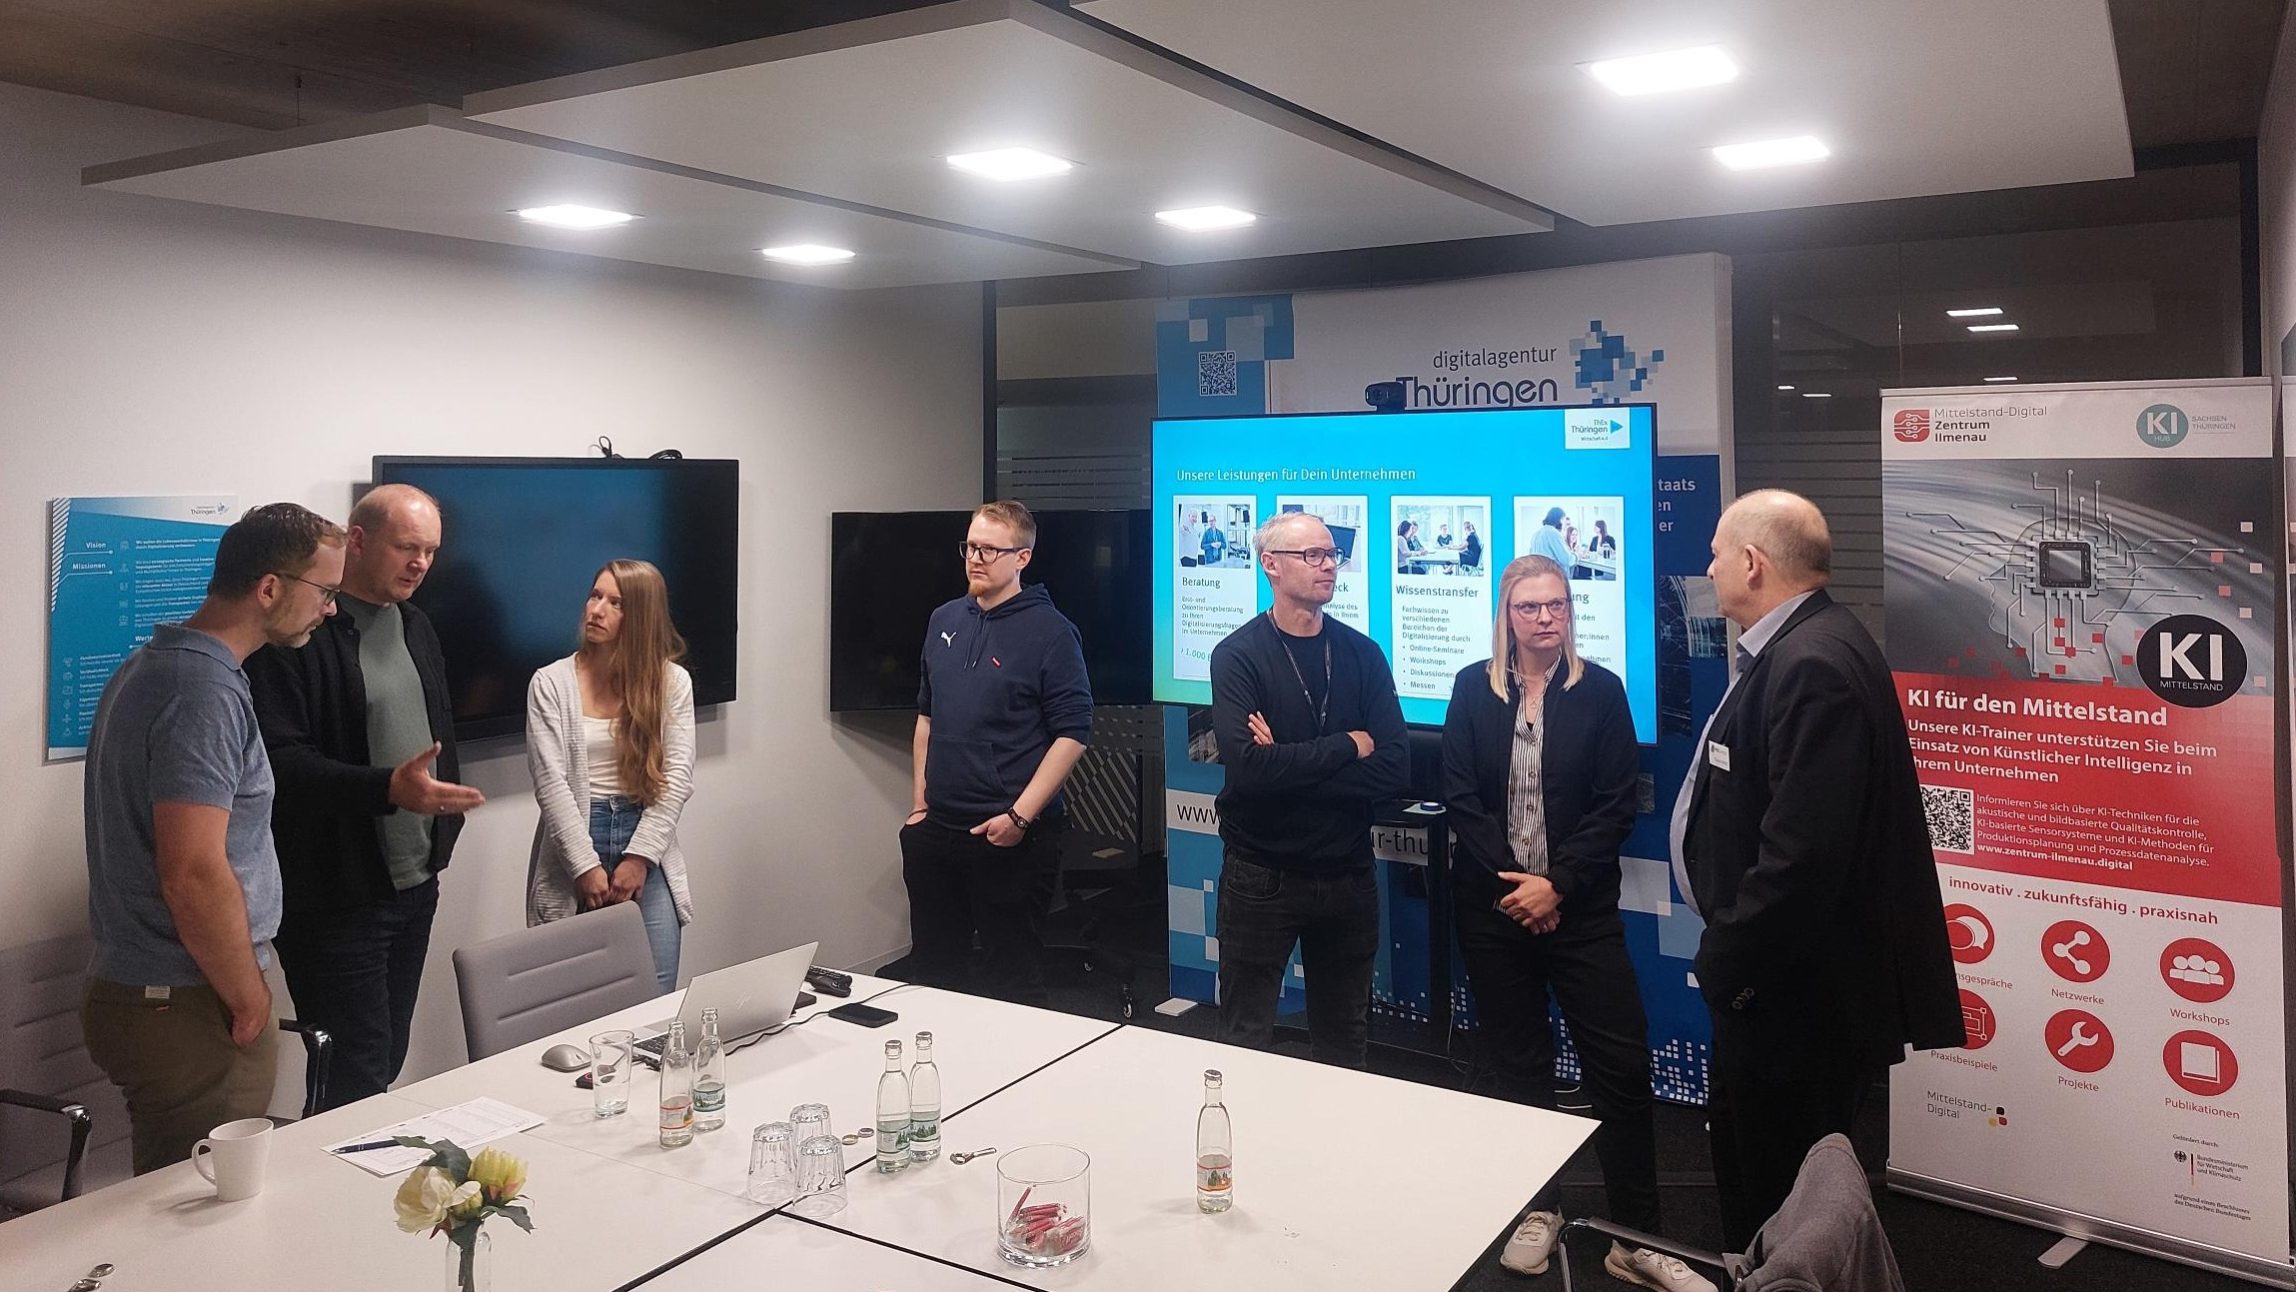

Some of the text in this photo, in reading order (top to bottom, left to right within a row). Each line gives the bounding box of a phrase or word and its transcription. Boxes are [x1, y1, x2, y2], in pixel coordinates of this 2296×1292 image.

[1432, 347, 1557, 371] digitalagentur
[1396, 376, 1558, 407] Thüringen
[1934, 406, 2047, 418] Mittelstand-Digital
[1571, 426, 1608, 434] Thüringen
[1935, 420, 1990, 430] Zentrum
[2147, 412, 2178, 435] KI
[1935, 433, 1987, 442] Ilmenau
[1177, 468, 1416, 483] Unsere Leistungen für Dein Unternehmen
[1658, 478, 1696, 491] taats
[1659, 521, 1674, 532] er
[85, 541, 106, 549] Vision
[72, 562, 106, 570] Missionen
[1182, 577, 1220, 589] Beratung
[1333, 582, 1349, 593] eck
[1396, 585, 1479, 598] Wissenstransfer
[1402, 605, 1439, 614] Fachwissen
[1402, 615, 1450, 623] verschiedenen
[1402, 624, 1435, 632] Bereichen
[1402, 633, 1470, 642] Digitalisierung durch
[1410, 644, 1464, 654] Online-Seminare
[2159, 632, 2223, 681] KI
[1410, 656, 1446, 666] Workshops
[1410, 668, 1454, 678] Diskussionen
[1410, 681, 1435, 689] Messen
[2160, 680, 2223, 692] MITTELSTAND
[1908, 689, 2167, 726] KI für den Mittelstand
[1908, 719, 2217, 757] Unsere KI-Trainer unterstützen Sie beim
[1909, 737, 2192, 775] Einsatz von Künstlicher Intelligenz in
[1914, 756, 2059, 783] hrem Unternehmen
[1977, 794, 2200, 826] Informieren Sie sich über KI-Techniken für die
[1977, 807, 2207, 841] akustische und bildbasierte Qualitätskontrolle,
[1977, 818, 2214, 853] KI-basierte Sensorsysteme und KI-Methoden für
[1977, 830, 2210, 867] Produktionsplanung und Prozessdatenanalyse.
[1977, 844, 2133, 871] www.zentrum-ilmenau.digital
[1949, 876, 2218, 924] innovativ zukunftsfähig praxisnah
[1956, 973, 2013, 989] nsgespräche
[2051, 988, 2105, 1005] Netzwerke
[2170, 1008, 2230, 1026] Workshops
[1930, 1050, 1998, 1072] Praxisbeispiele
[2058, 1076, 2099, 1091] Projekte
[1927, 1090, 1992, 1112] Mittelstand-
[2165, 1097, 2240, 1119] Publikationen
[1927, 1103, 1960, 1118] Digital
